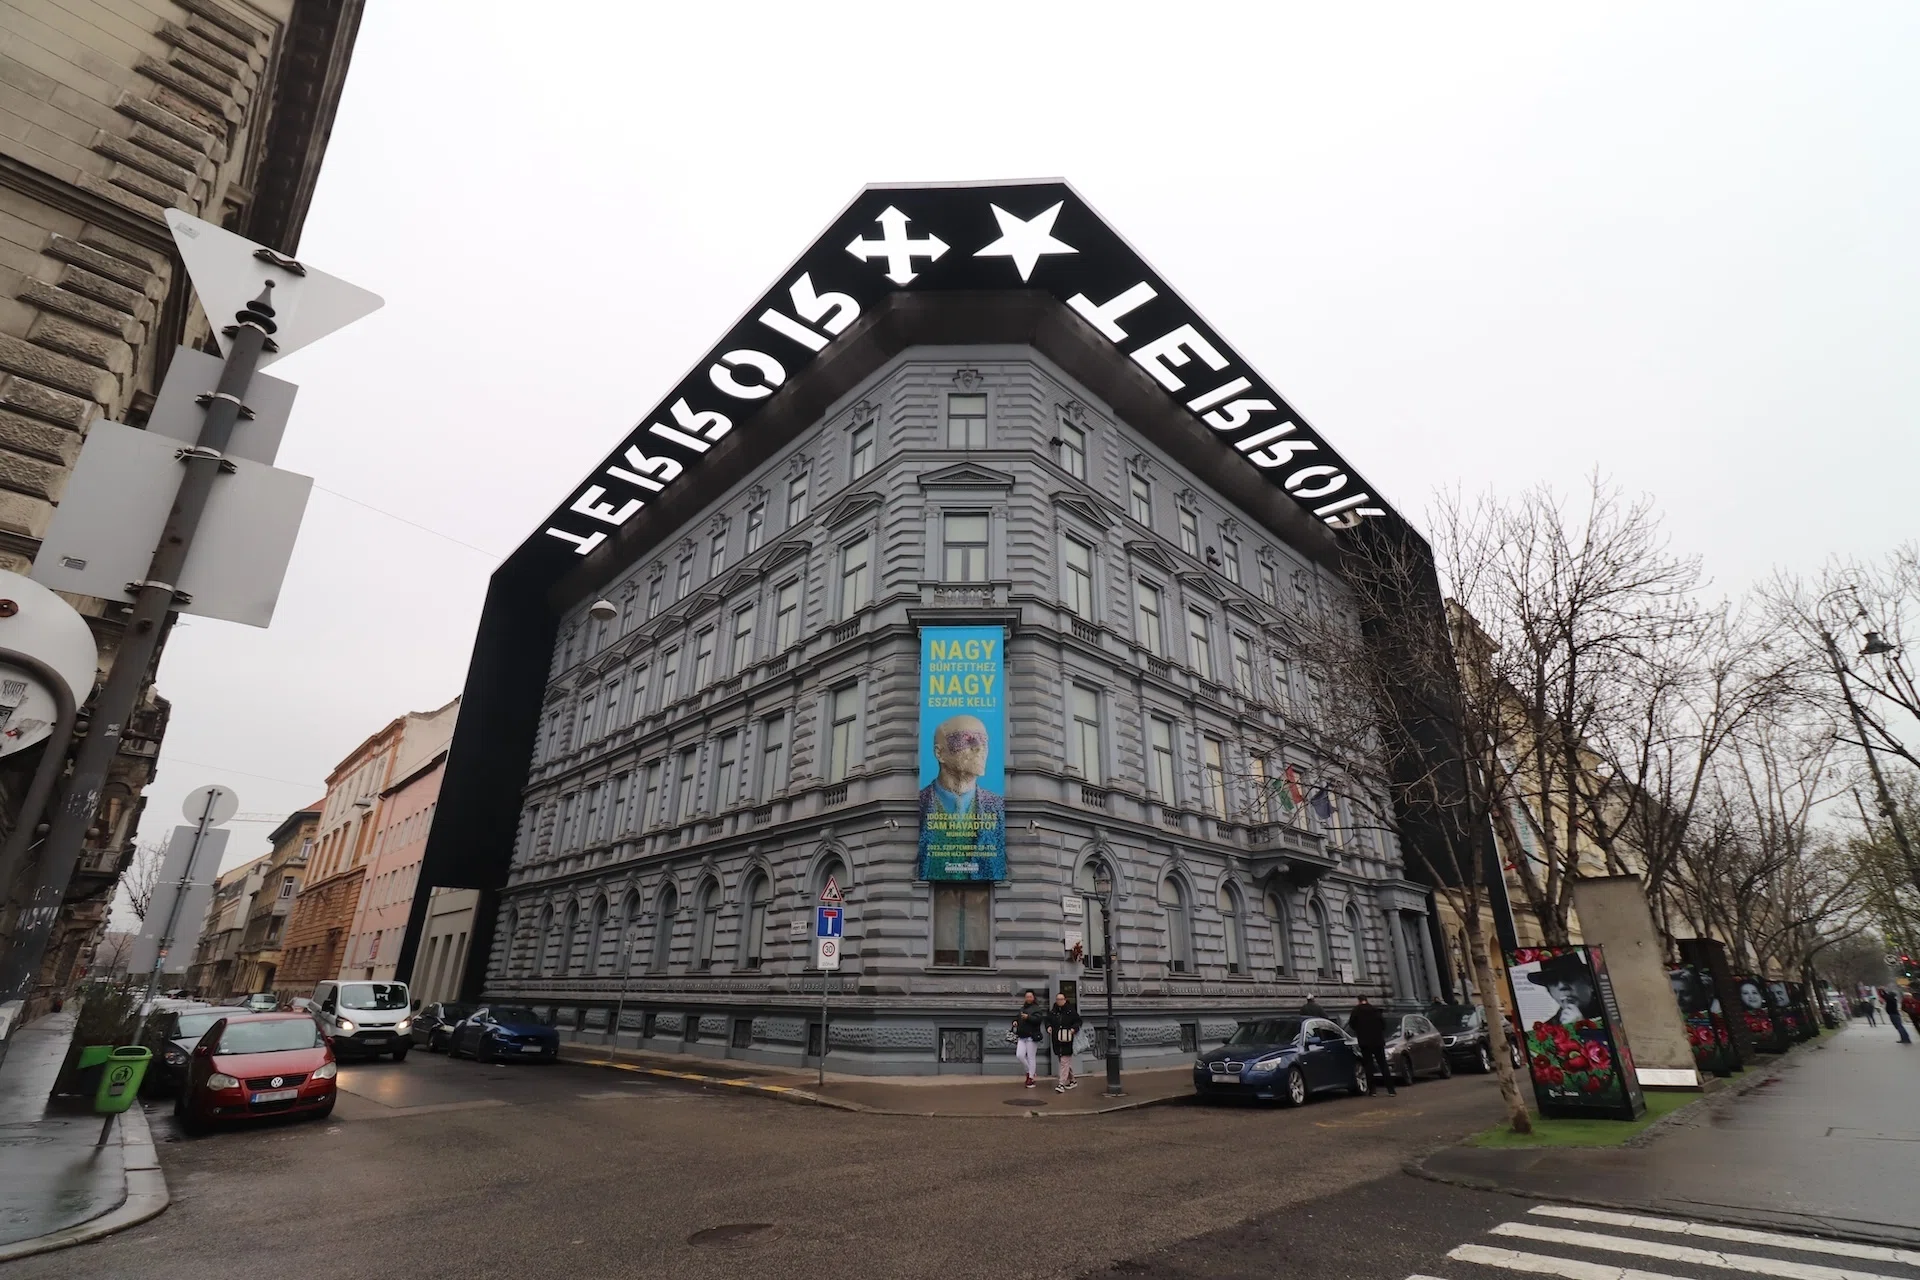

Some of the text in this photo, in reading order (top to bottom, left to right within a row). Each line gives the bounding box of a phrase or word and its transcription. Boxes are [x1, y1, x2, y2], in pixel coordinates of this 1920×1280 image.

[930, 639, 996, 660] NAGY
[929, 674, 995, 695] NAGY
[928, 697, 965, 707] ESZME
[927, 821, 997, 830] SAM HAVADTOY
[825, 945, 833, 954] 30
